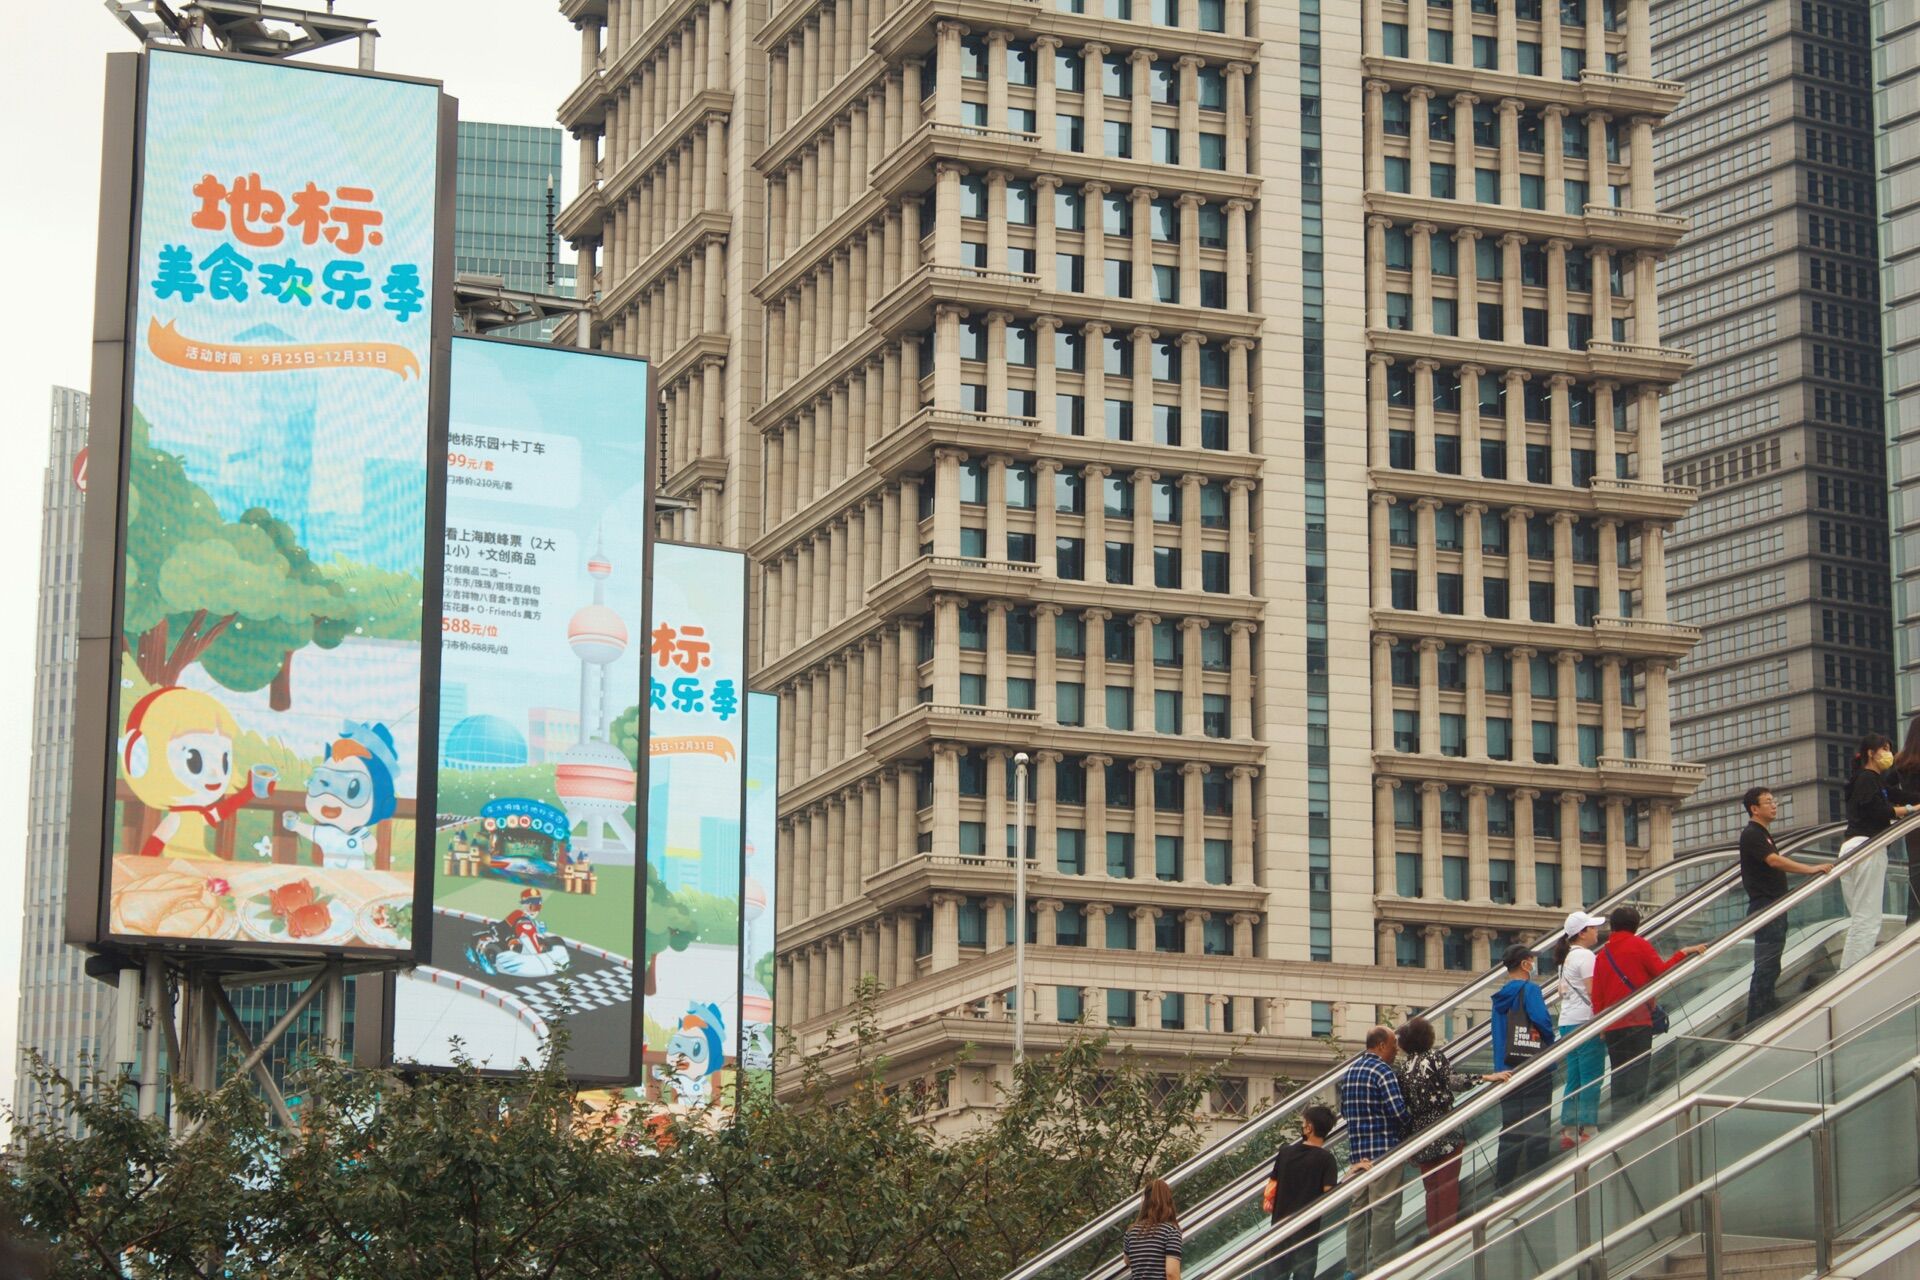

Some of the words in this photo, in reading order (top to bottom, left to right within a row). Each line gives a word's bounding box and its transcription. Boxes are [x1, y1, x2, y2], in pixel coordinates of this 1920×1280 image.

[191, 172, 383, 254] 地标
[151, 242, 425, 322] 美食欢乐季
[652, 622, 711, 673] 标
[1517, 1040, 1541, 1048] ORANGE
